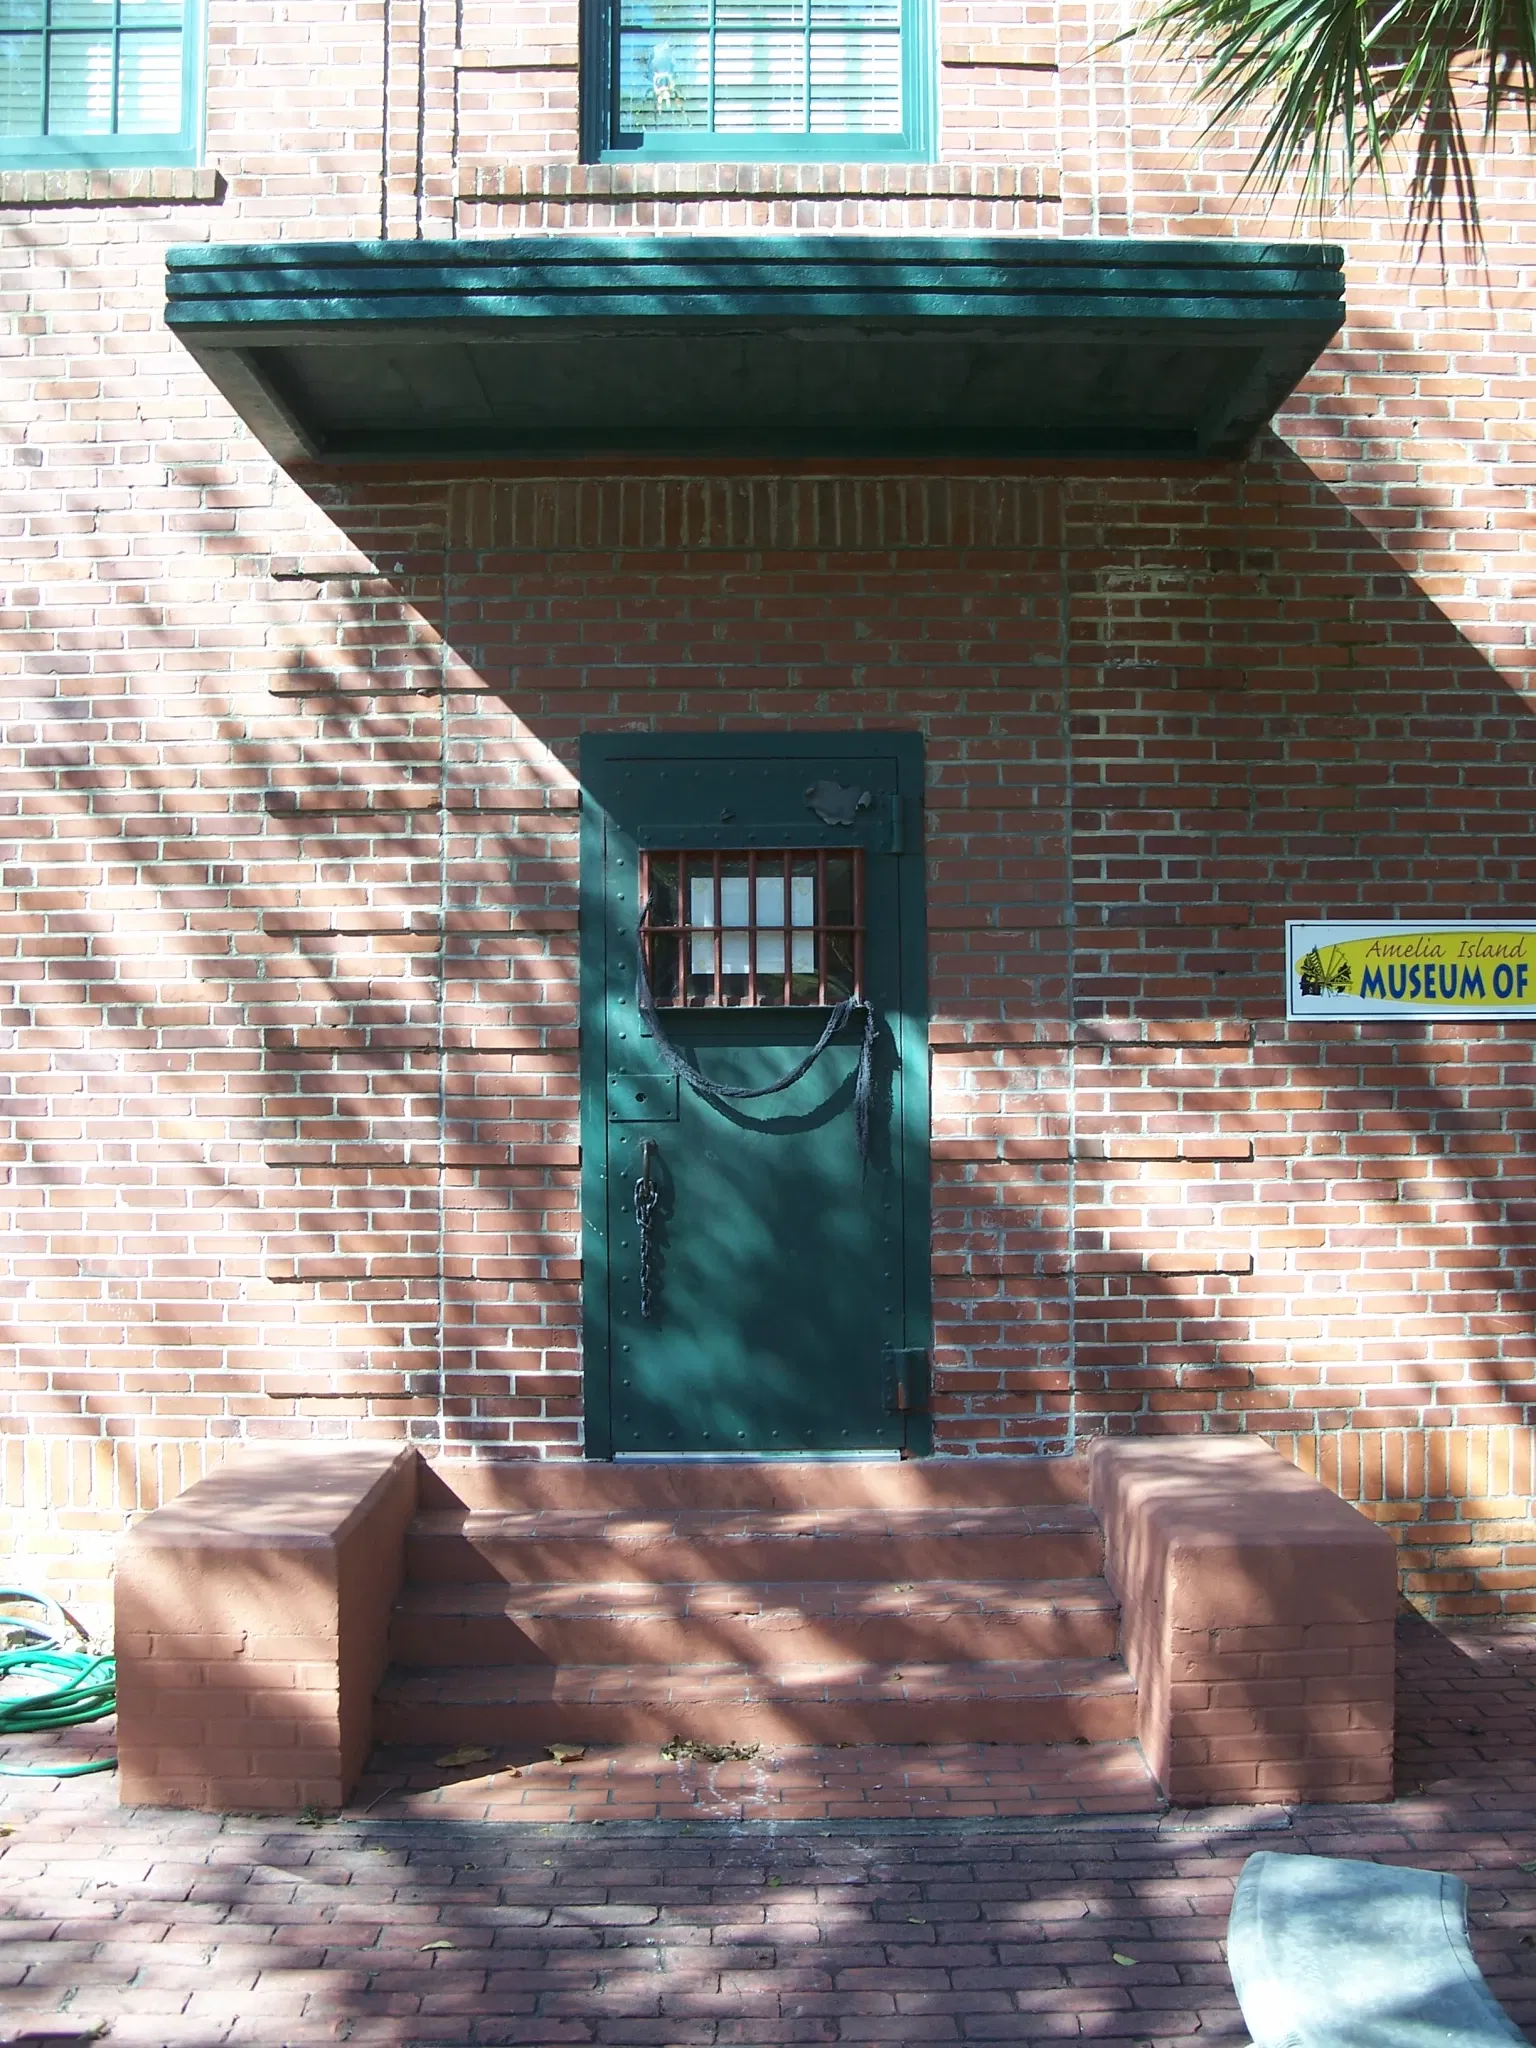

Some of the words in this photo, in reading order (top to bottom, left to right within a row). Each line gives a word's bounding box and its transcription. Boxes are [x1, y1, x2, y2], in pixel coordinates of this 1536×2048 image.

[1365, 936, 1447, 958] Amelia
[1457, 936, 1528, 958] Island
[1359, 963, 1486, 999] MUSEUM
[1492, 963, 1528, 999] OF
